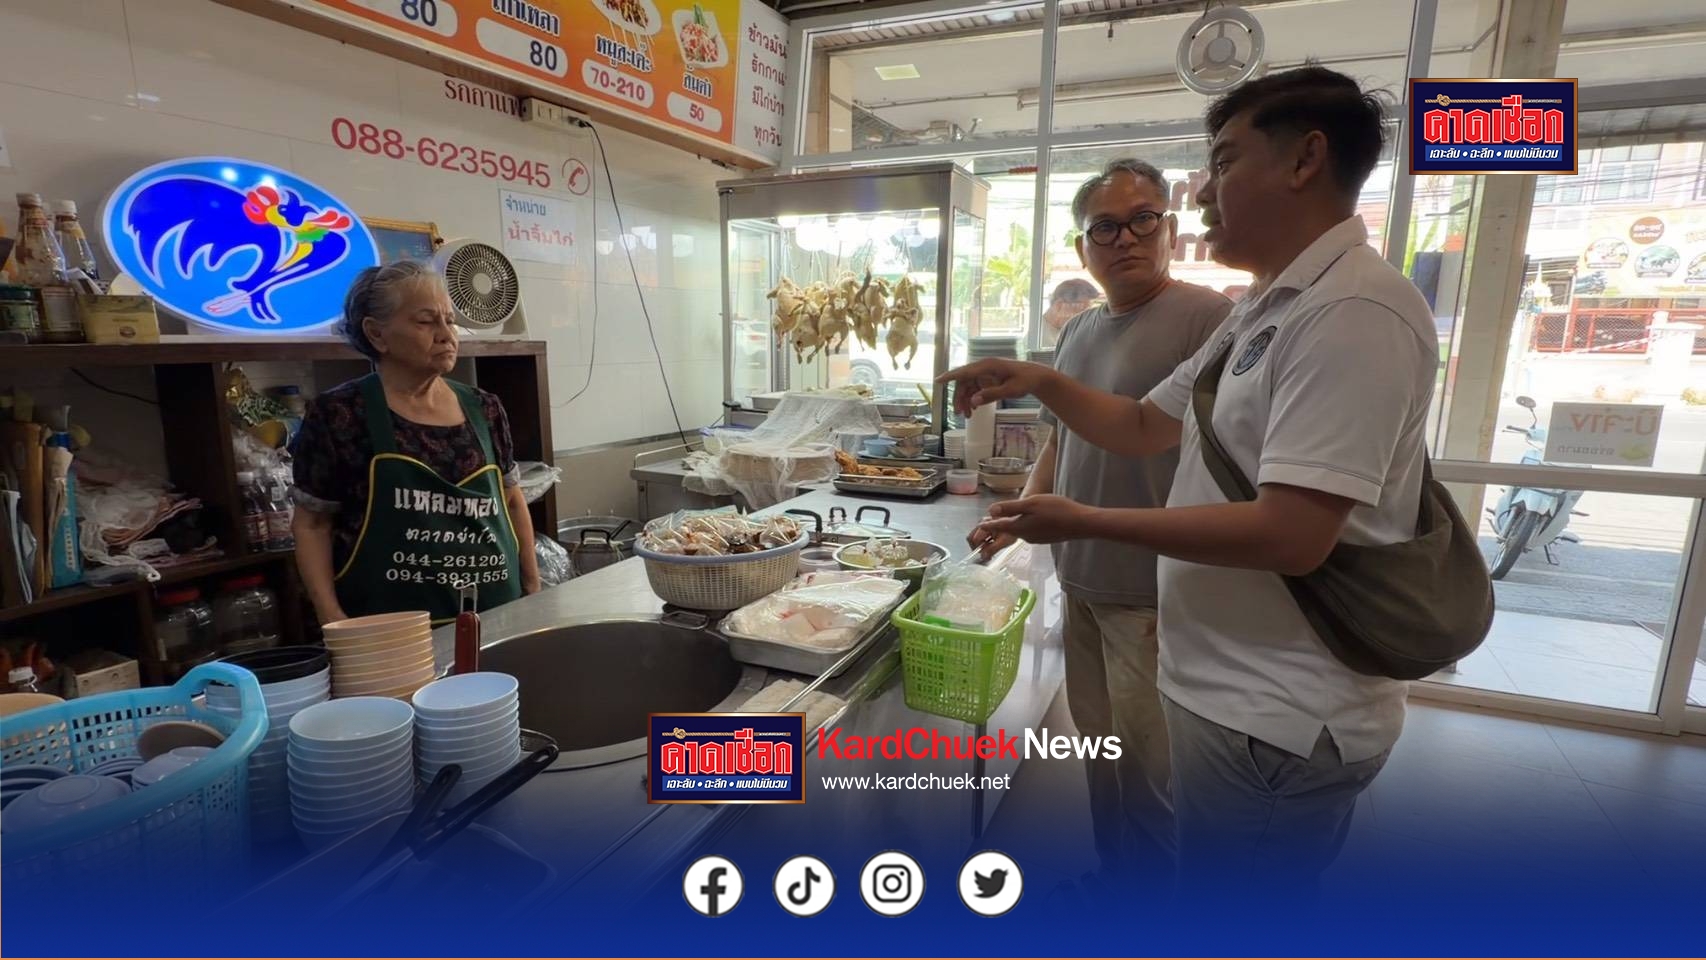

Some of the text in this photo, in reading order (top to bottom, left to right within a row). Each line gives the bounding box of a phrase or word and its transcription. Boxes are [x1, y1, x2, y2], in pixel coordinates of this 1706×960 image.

[530, 40, 557, 71] 80
[591, 66, 645, 101] 70-210
[689, 103, 705, 121] 50
[331, 117, 551, 188] 088-6235945
[393, 551, 506, 567] 044-261202
[386, 568, 509, 585] 094-3931555
